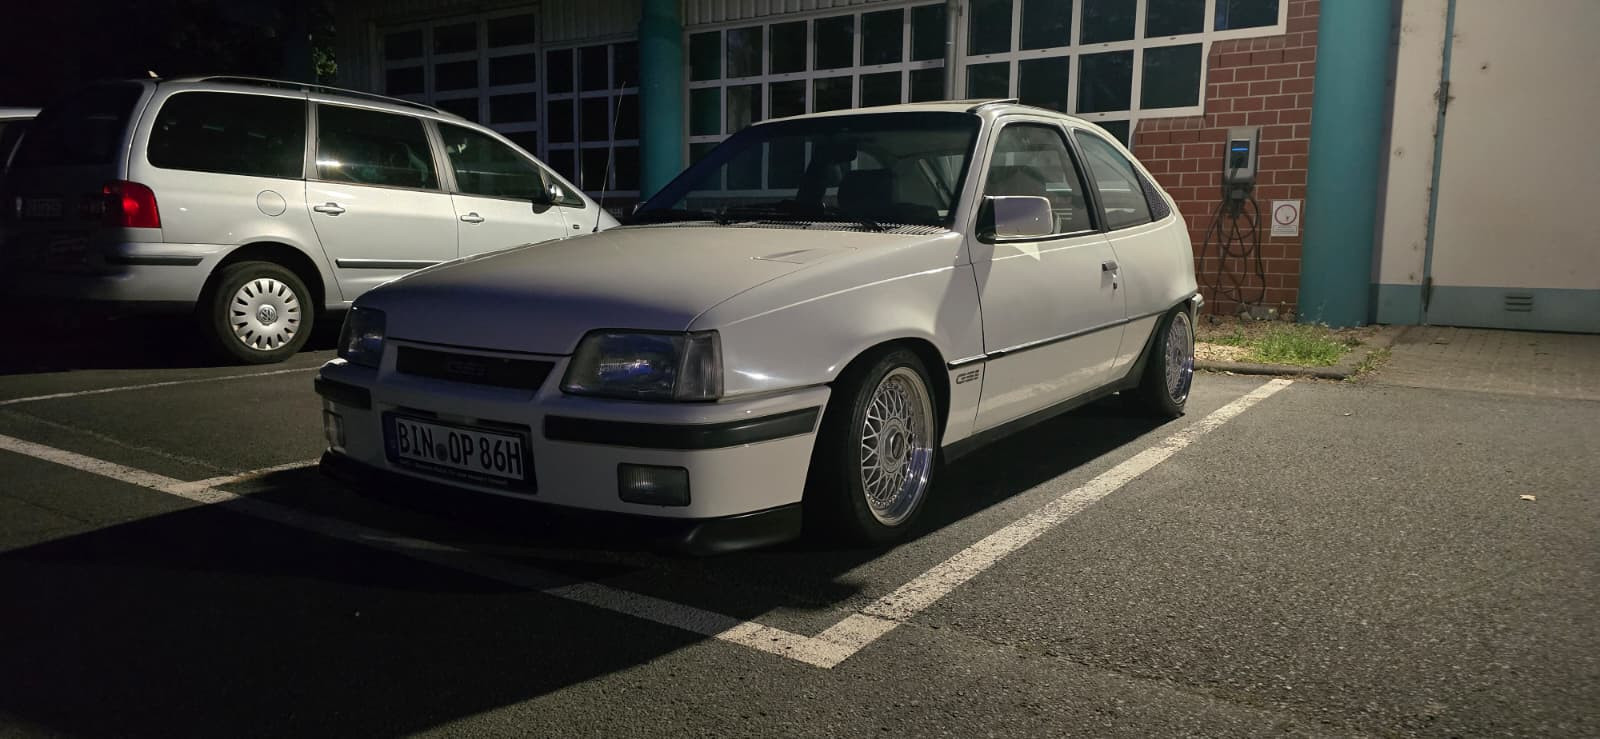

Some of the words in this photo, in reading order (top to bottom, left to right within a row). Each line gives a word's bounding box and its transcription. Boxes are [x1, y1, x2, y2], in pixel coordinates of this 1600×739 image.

[398, 422, 434, 458] BIN
[449, 431, 474, 465] OP
[479, 436, 522, 475] 86H
